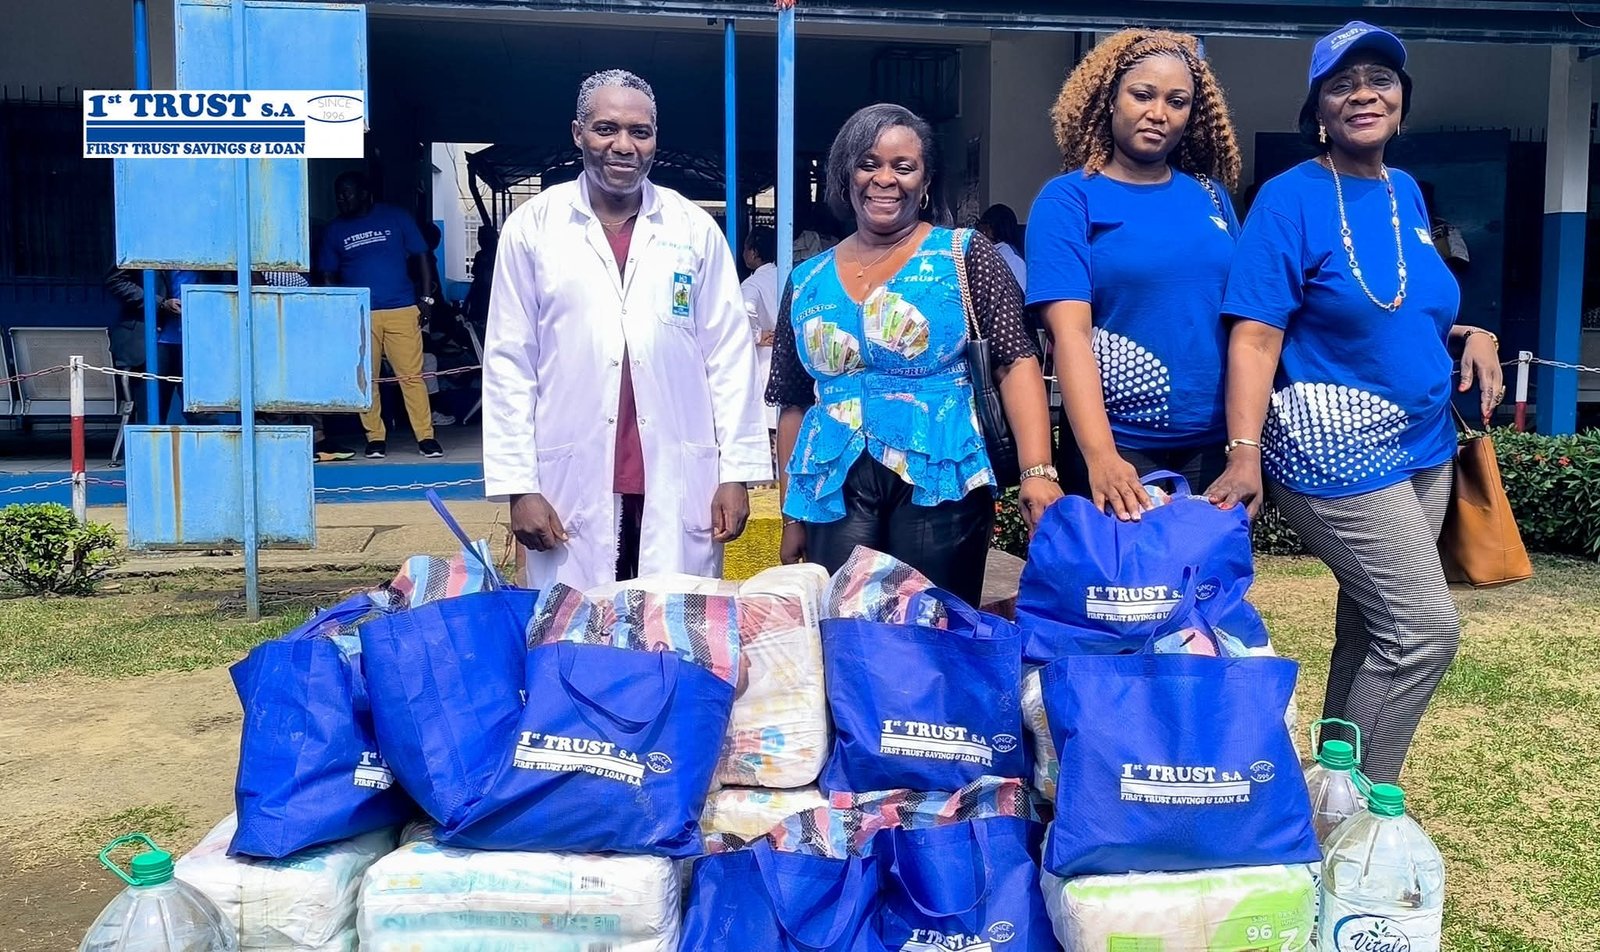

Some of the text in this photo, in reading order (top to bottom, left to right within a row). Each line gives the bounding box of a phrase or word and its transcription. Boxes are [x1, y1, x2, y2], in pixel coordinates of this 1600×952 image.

[1105, 585, 1168, 601] TRUST
[1105, 613, 1126, 622] TRUST
[1127, 612, 1156, 622] SAVINGS
[881, 720, 987, 745] 1st TRUST S.A
[993, 737, 1013, 745] SINCE
[518, 731, 638, 762] 1st TRUST S.A
[649, 753, 670, 766] SINCE
[880, 746, 900, 755] FIRST
[901, 748, 924, 757] TRUST
[925, 750, 955, 760] SAVINGS
[961, 754, 980, 763] LOAN
[981, 758, 992, 767] S.A
[512, 760, 535, 770] FIRST
[536, 762, 562, 772] TRUST
[563, 764, 595, 775] SAVINGS
[605, 769, 626, 781] LOAN
[627, 776, 641, 786] S.A
[1121, 763, 1242, 782] 1st TRUST S.A
[1253, 763, 1271, 774] SINCE
[1120, 793, 1143, 801] FIRST
[1143, 795, 1171, 804] TRUST
[1172, 796, 1205, 805] SAVINGS
[1214, 795, 1235, 804] LOAN
[1236, 793, 1250, 803] S.A
[910, 928, 926, 941] 1st
[965, 934, 982, 945] S.A
[990, 924, 1010, 935] SINCE
[1246, 923, 1272, 943] 96
[1350, 932, 1408, 952] Vitale
